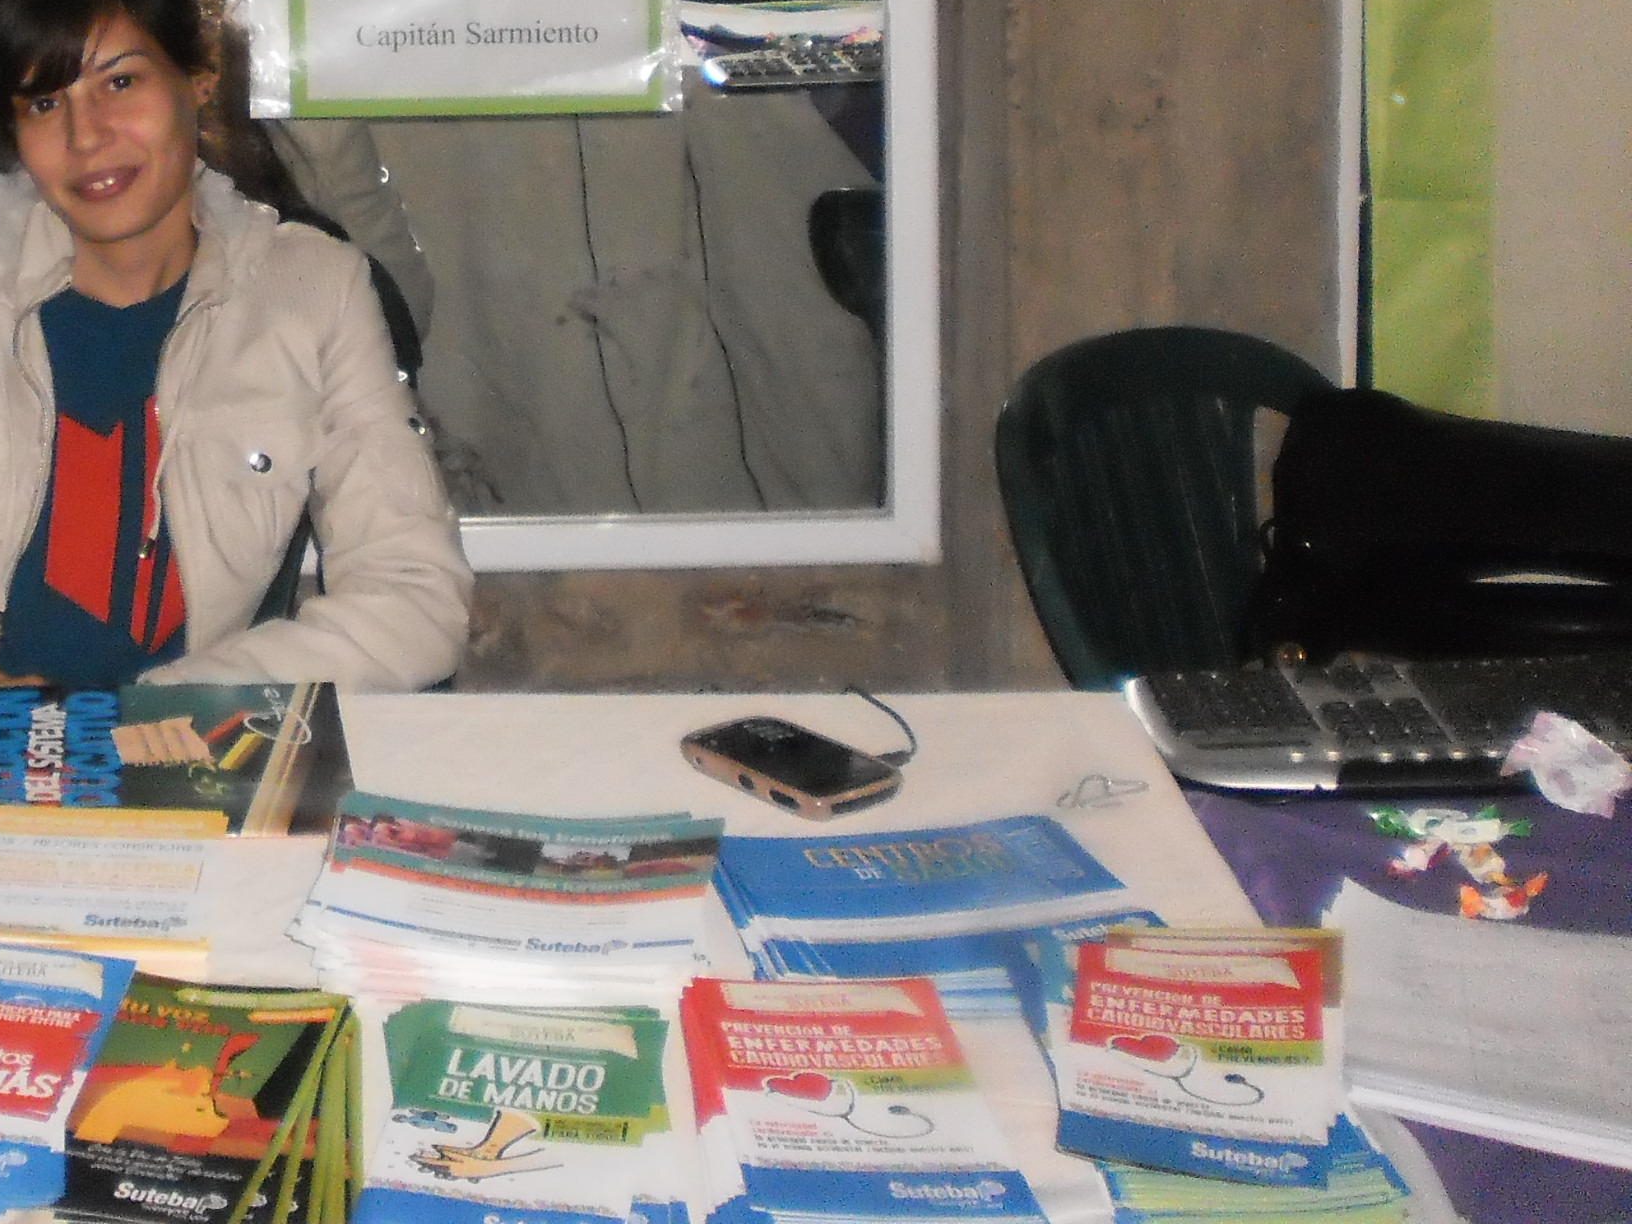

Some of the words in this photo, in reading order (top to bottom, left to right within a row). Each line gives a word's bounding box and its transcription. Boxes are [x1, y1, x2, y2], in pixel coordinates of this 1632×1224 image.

[356, 21, 456, 50] Capitán
[465, 19, 600, 48] Sarmiento
[83, 913, 162, 930] Suteba
[525, 937, 601, 954] Suteba
[1090, 995, 1306, 1025] ENFERMEDADES
[1202, 995, 1222, 1008] DE
[832, 1022, 853, 1037] DE
[1086, 1006, 1306, 1040] CARDIOVASCULARES
[726, 1034, 945, 1055] ENFERMEDADES
[445, 1047, 607, 1094] LAVADO
[438, 1076, 474, 1099] DE
[482, 1082, 600, 1115] MANOS
[1190, 1140, 1284, 1171] Suteba
[114, 1178, 199, 1209] Suteba
[888, 1178, 979, 1201] Suteba
